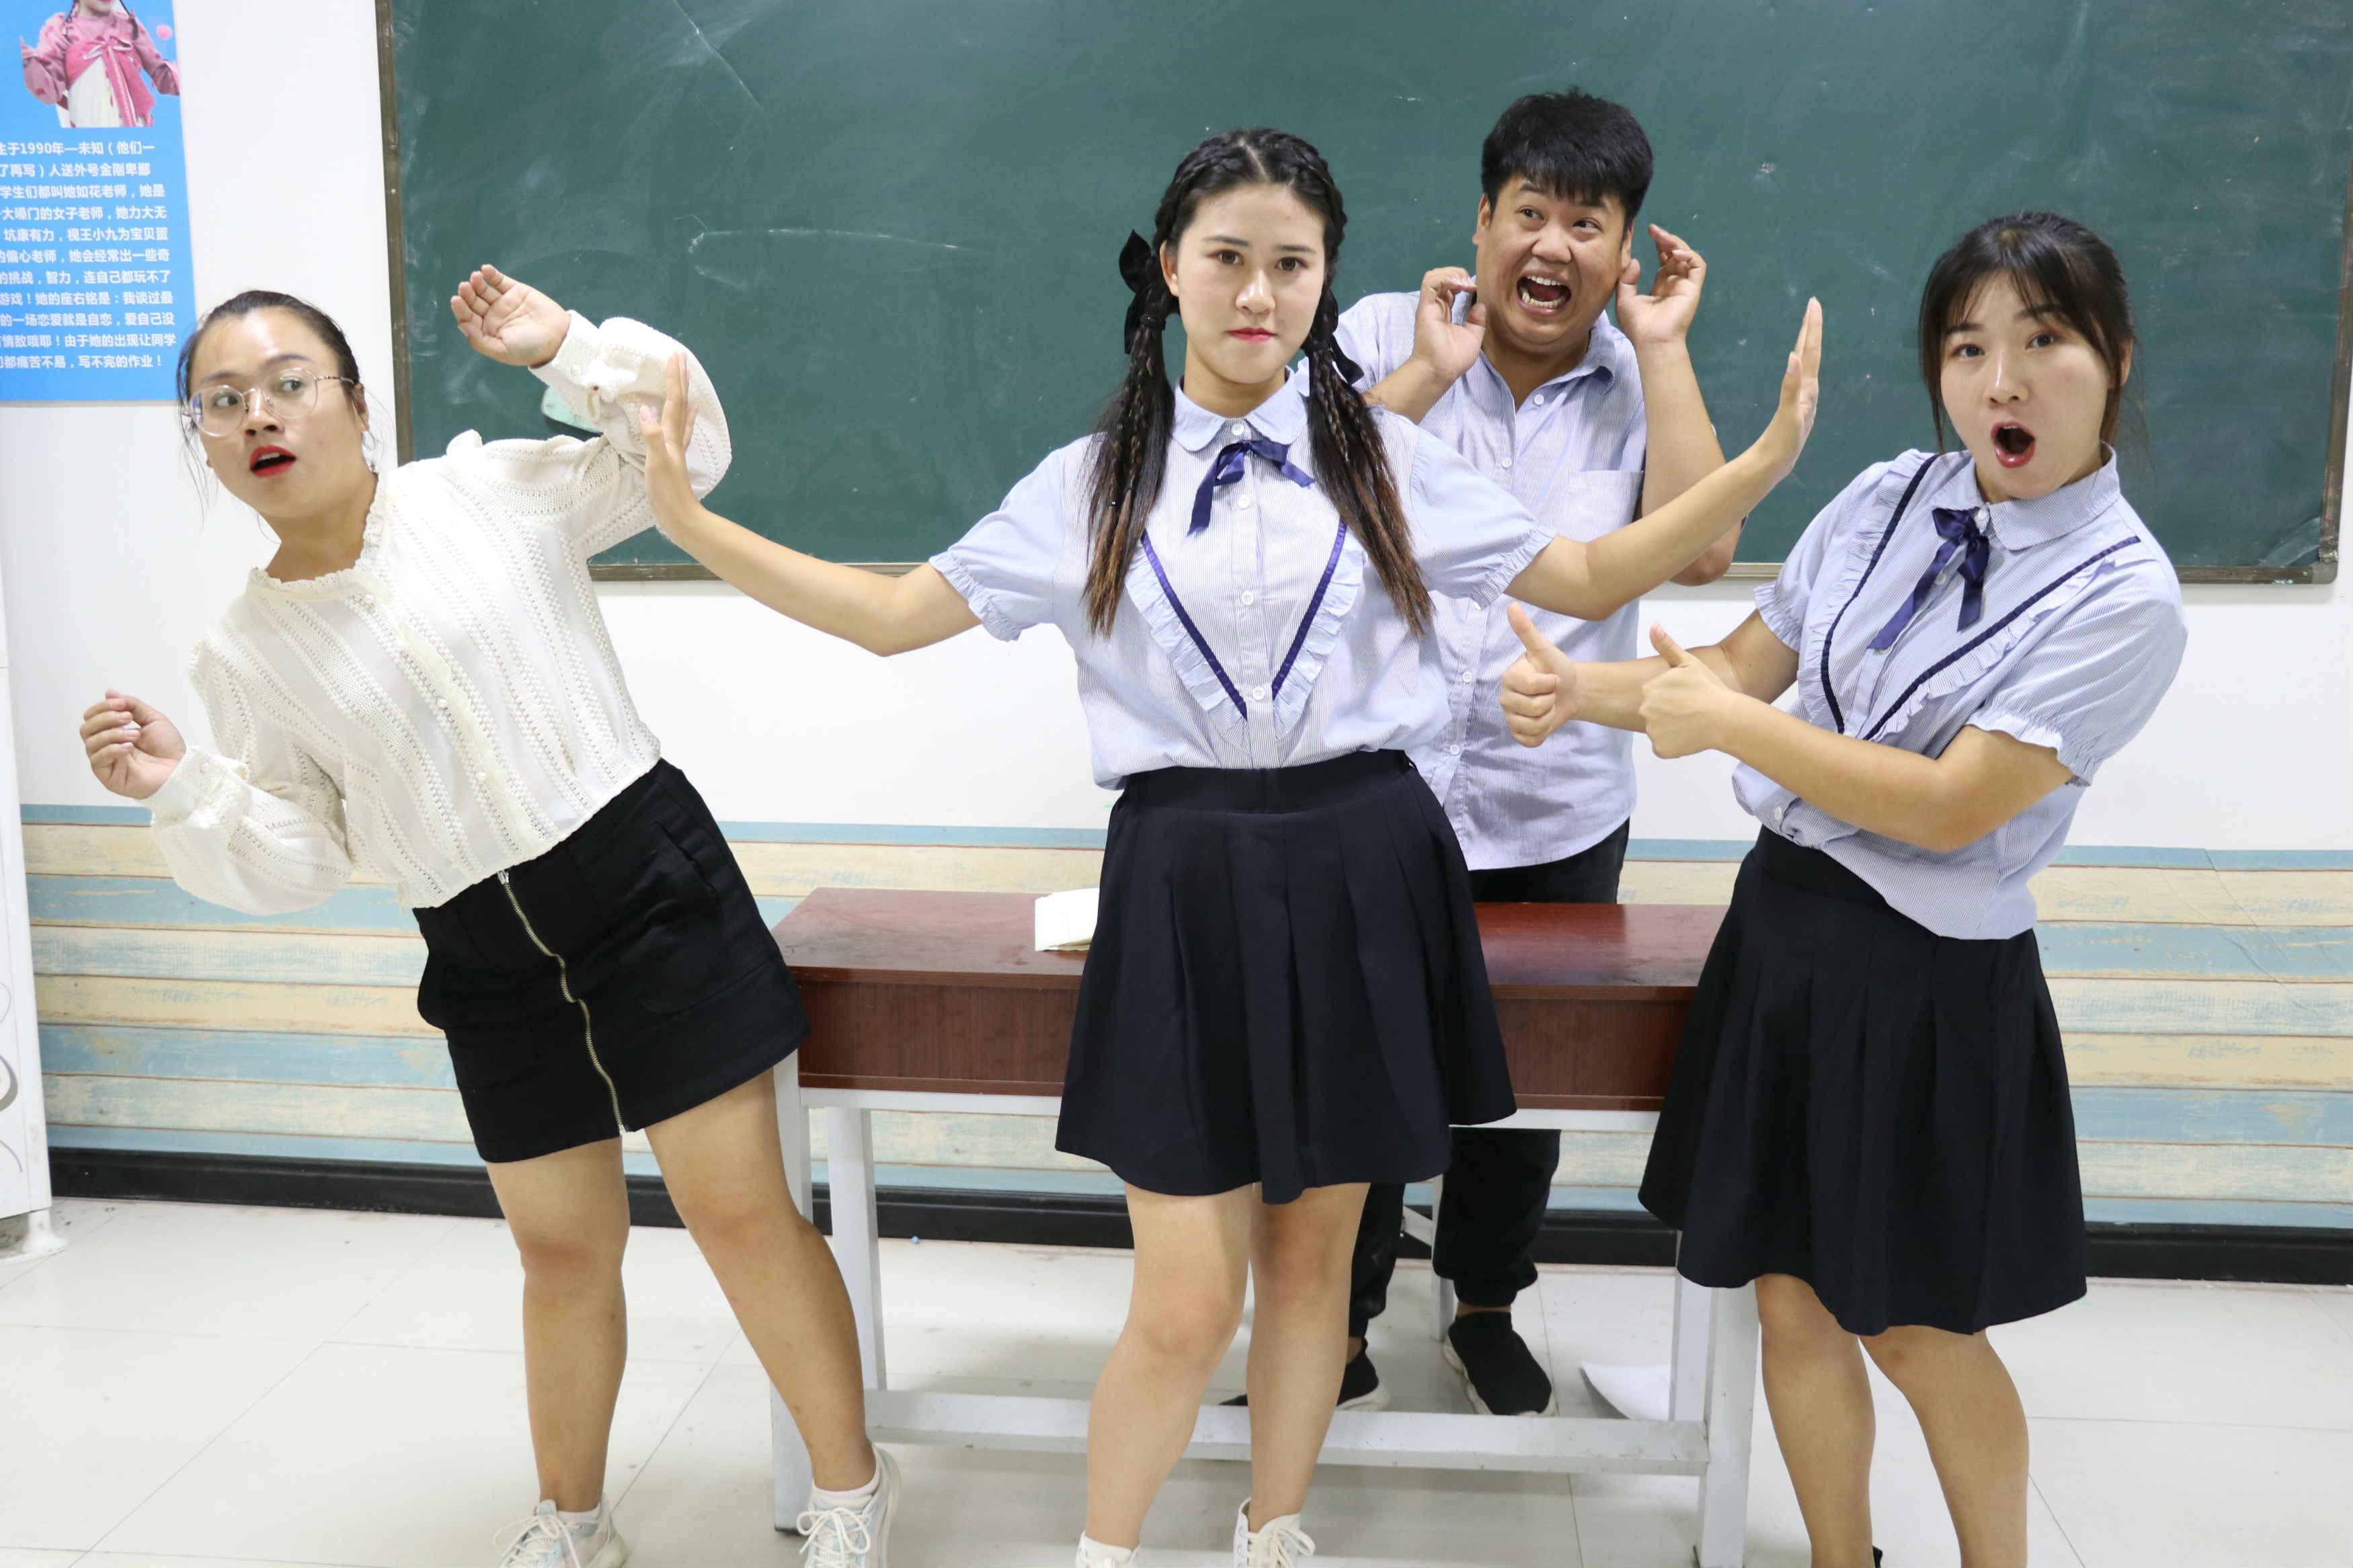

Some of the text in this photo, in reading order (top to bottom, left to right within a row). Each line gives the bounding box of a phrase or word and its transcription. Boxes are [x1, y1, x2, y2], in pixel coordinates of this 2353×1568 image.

[0, 207, 166, 221] 大嗓门的女子老师，她力大无
